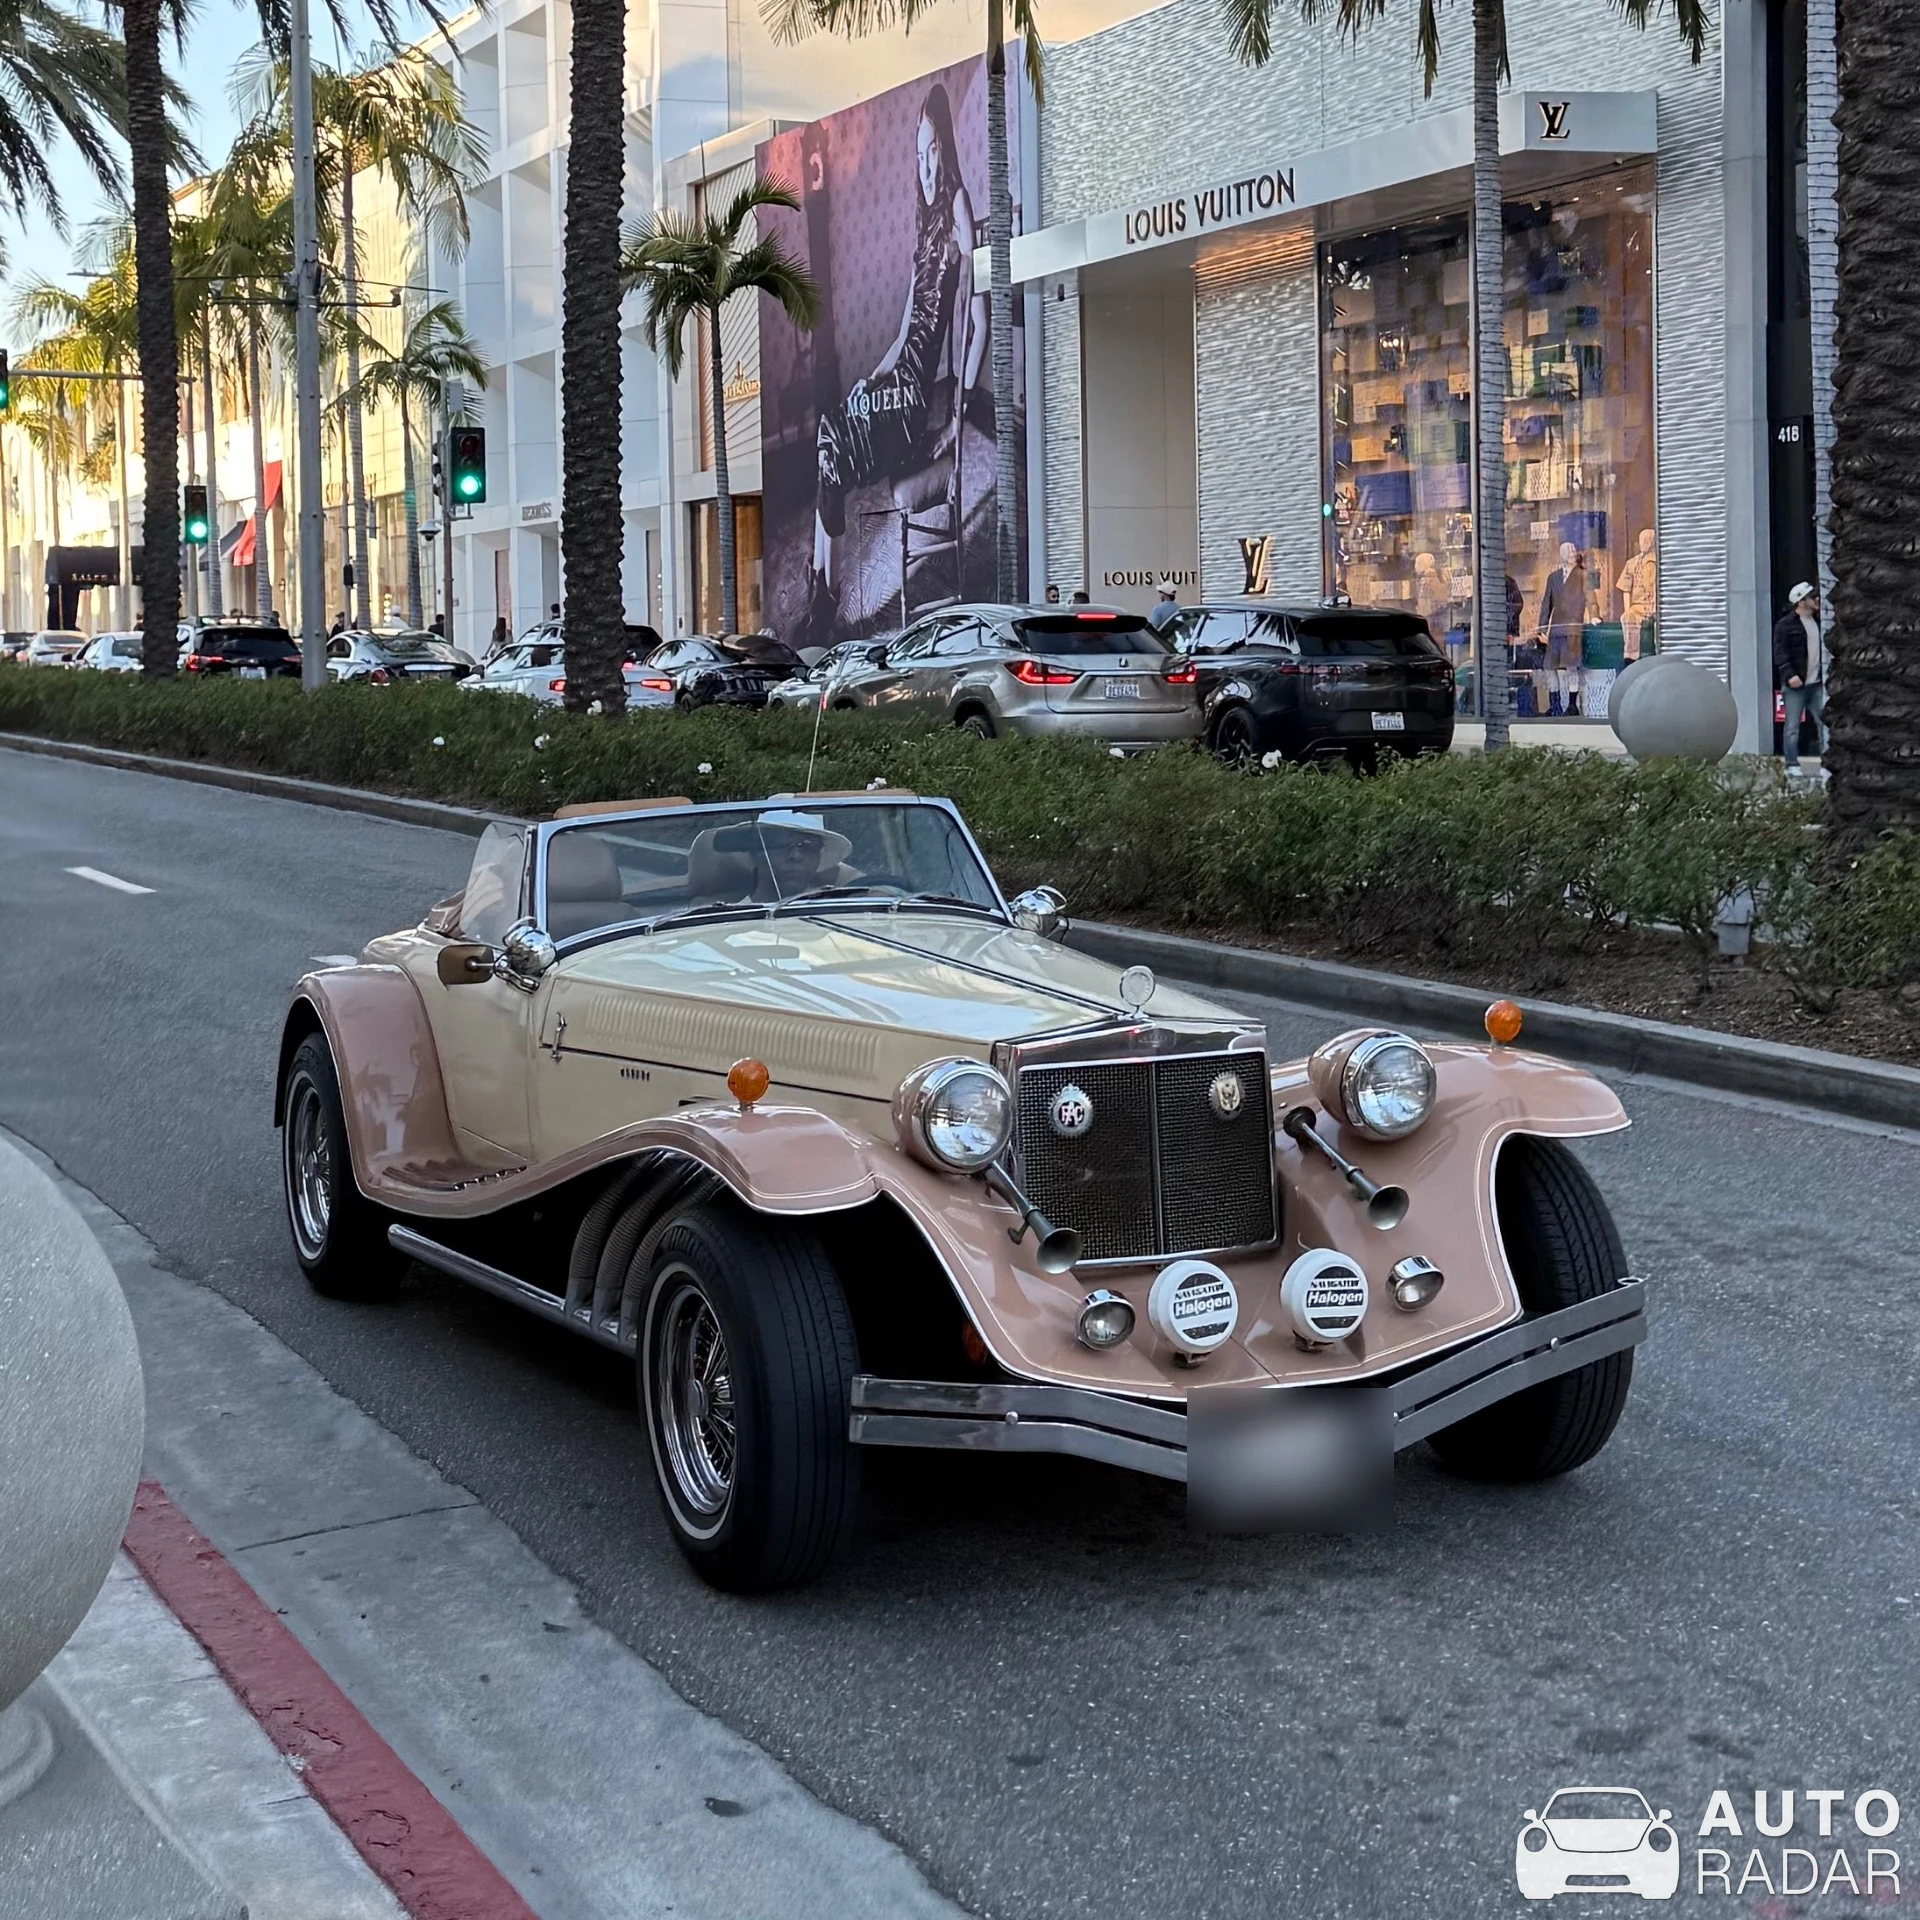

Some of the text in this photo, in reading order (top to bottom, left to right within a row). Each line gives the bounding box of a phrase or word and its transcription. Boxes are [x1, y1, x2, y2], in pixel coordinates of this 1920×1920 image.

[1126, 167, 1296, 245] LOUIS VUITTON
[1104, 571, 1154, 587] LOUIS
[1175, 1295, 1231, 1317] Halogen
[1307, 1290, 1363, 1307] Halogen
